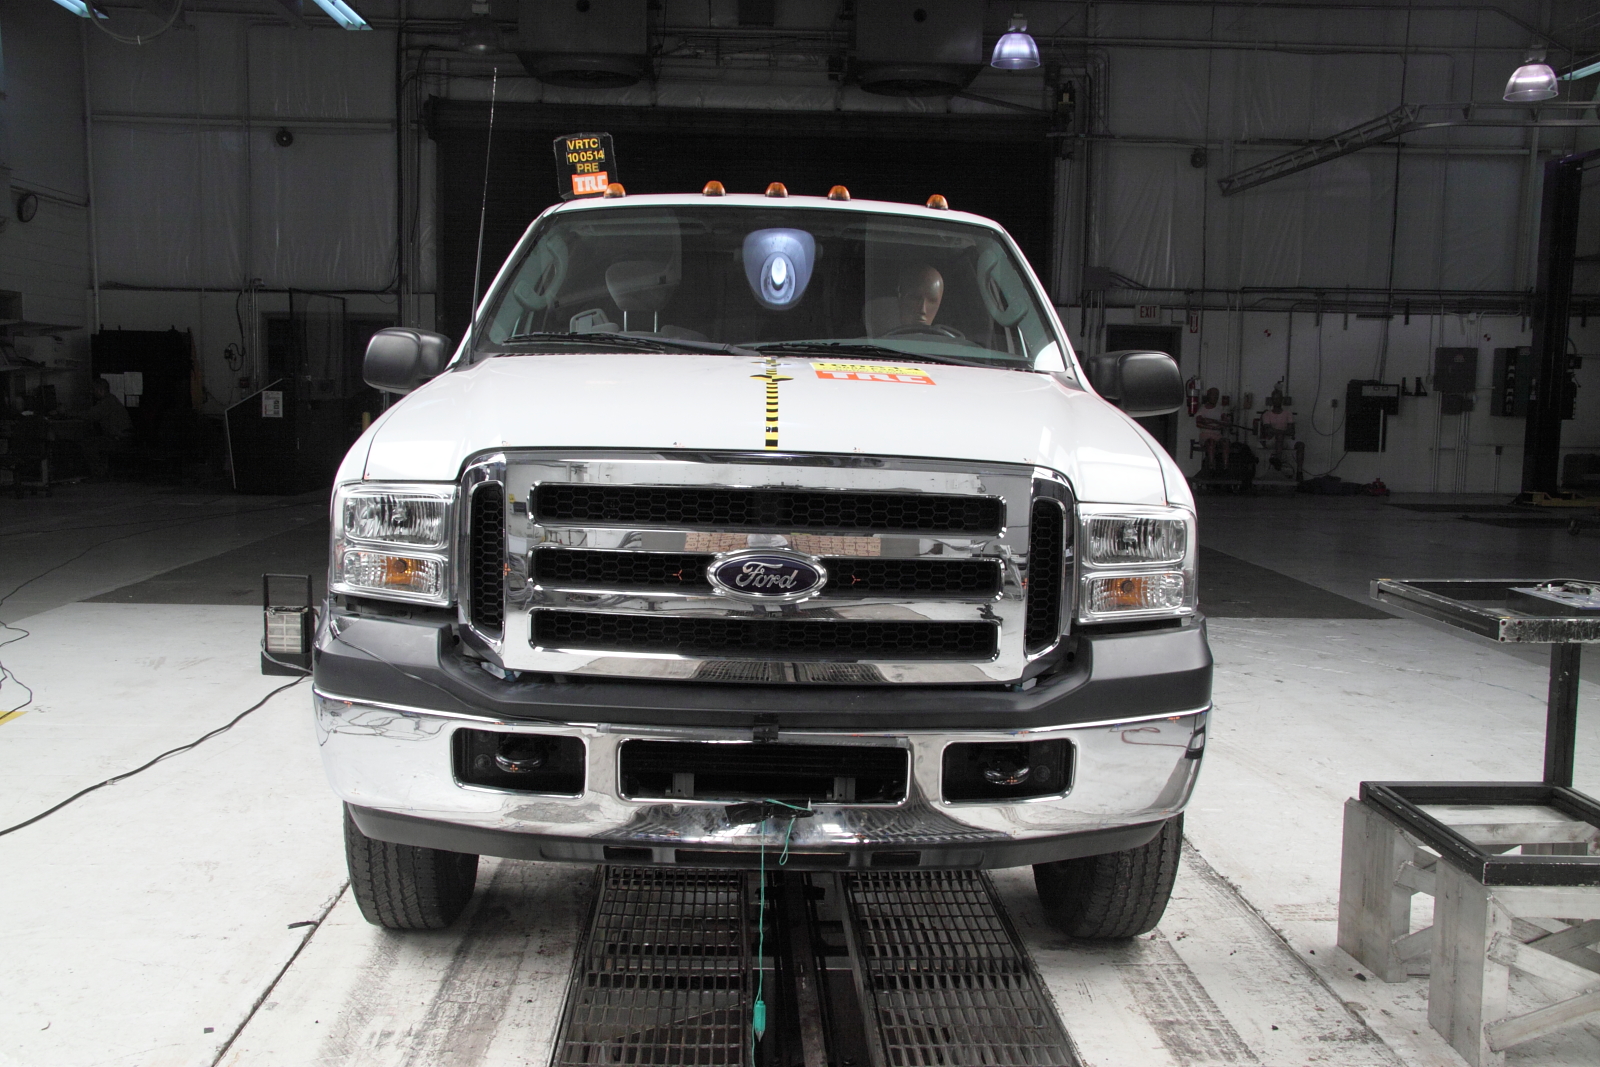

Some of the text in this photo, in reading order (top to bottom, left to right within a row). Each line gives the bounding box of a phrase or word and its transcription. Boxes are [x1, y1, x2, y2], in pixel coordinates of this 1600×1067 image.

[567, 138, 598, 150] VRTC
[577, 162, 599, 174] PRE
[574, 175, 607, 192] TRC
[1140, 305, 1157, 318] EXIT
[735, 561, 798, 588] Ford
